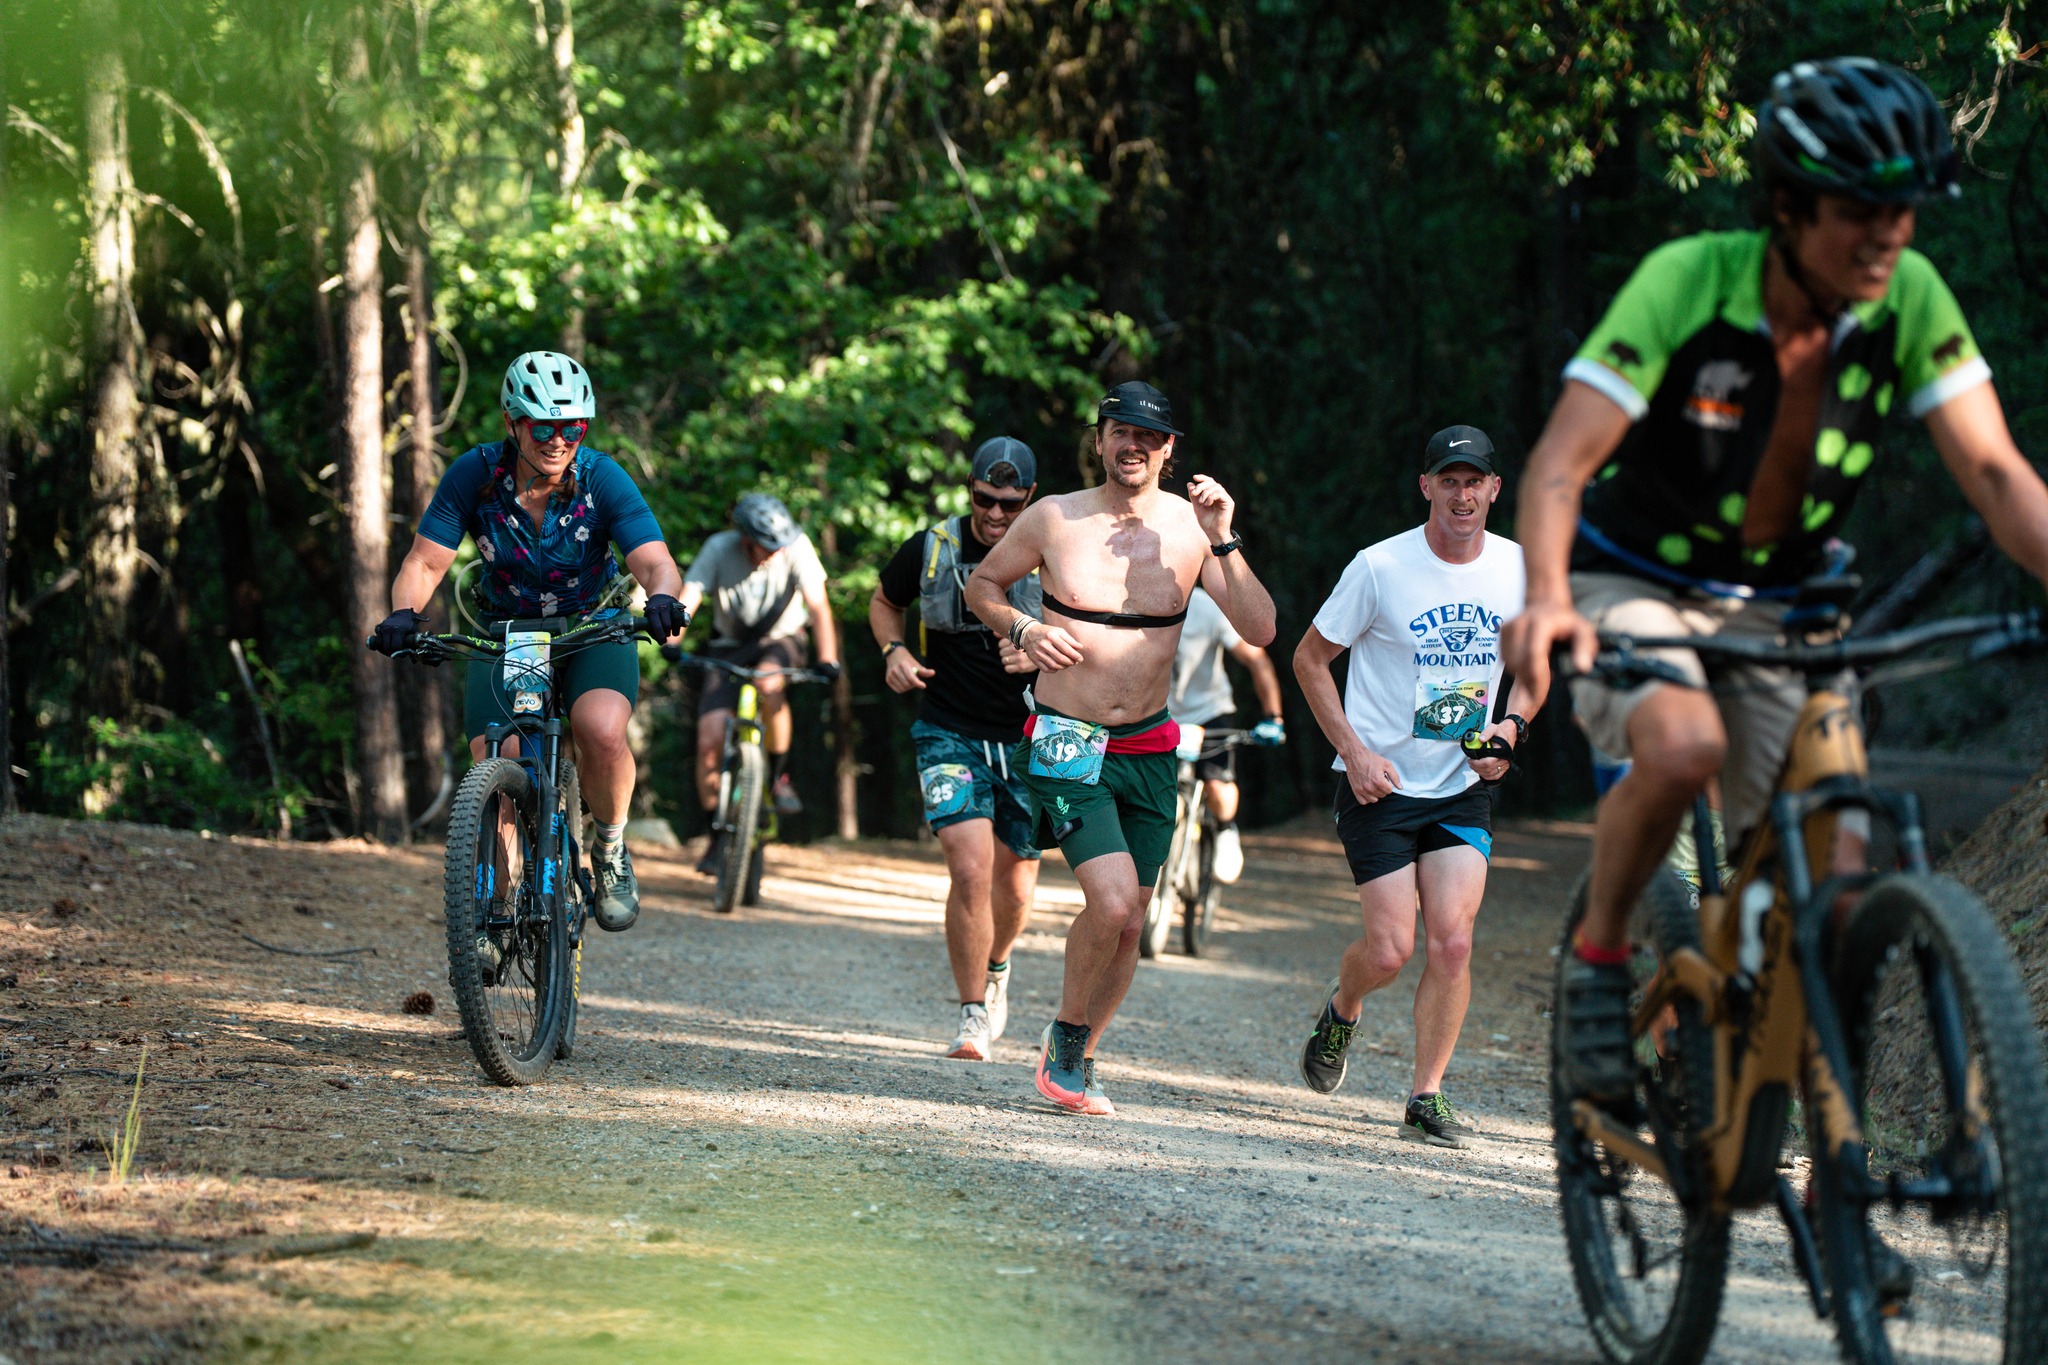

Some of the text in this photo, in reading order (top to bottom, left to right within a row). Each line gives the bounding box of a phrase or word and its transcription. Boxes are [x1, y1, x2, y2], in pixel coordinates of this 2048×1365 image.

[1409, 603, 1504, 638] STEENS
[1413, 652, 1498, 666] MOUNTAIN
[1440, 706, 1466, 724] 37
[1055, 742, 1078, 762] 19
[931, 783, 954, 804] 25
[542, 856, 557, 896] FOX
